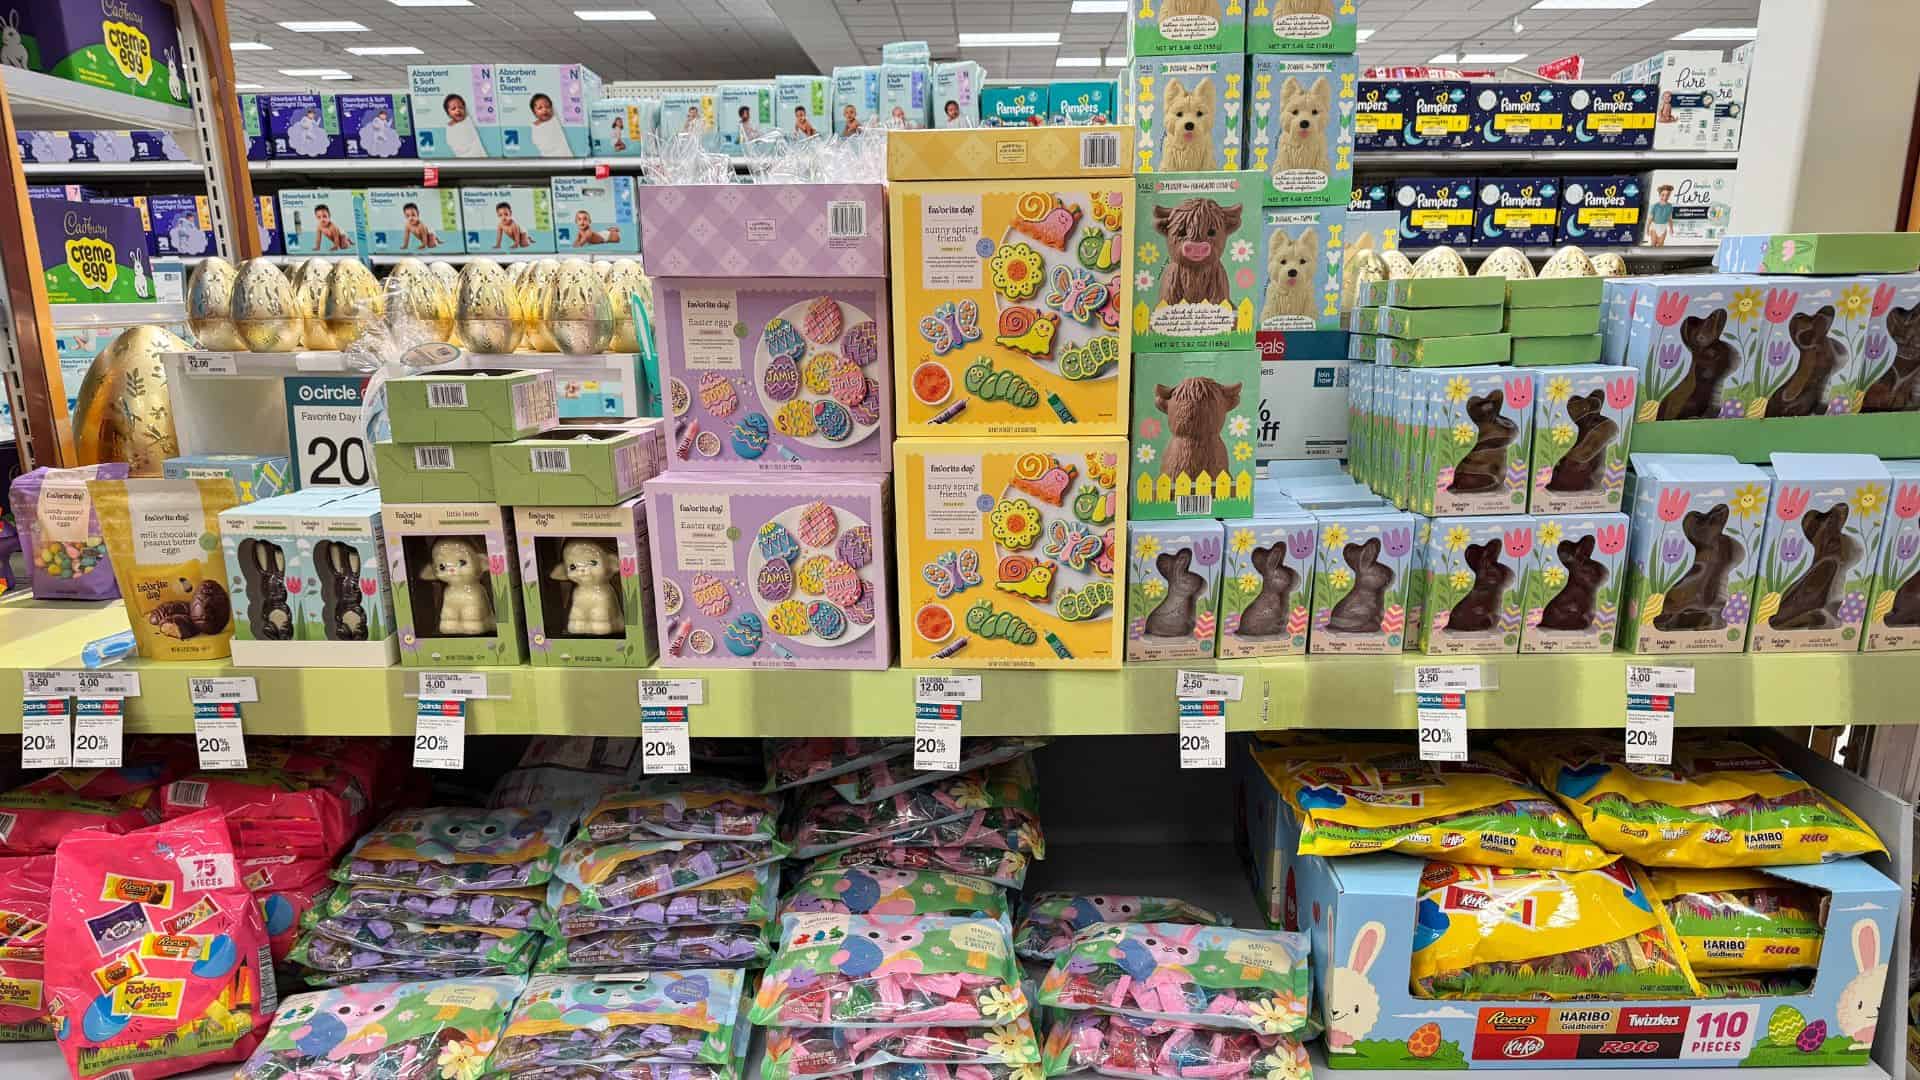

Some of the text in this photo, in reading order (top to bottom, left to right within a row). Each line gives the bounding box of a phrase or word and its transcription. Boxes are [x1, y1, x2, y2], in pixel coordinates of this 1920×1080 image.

[109, 27, 148, 58] creme
[119, 47, 144, 75] egg
[482, 69, 490, 80] N
[499, 69, 536, 77] Absorbent
[569, 68, 578, 79] N
[1675, 67, 1706, 89] Pure
[420, 77, 434, 85] Soft
[507, 76, 521, 84] Soft
[499, 84, 527, 93] Diapers
[996, 103, 1034, 116] Pampers
[1061, 102, 1099, 116] Pampers
[1357, 101, 1387, 112] mpers
[1416, 99, 1457, 114] Pampers
[1501, 98, 1541, 112] Pampers
[1593, 97, 1633, 113] Pampers
[1351, 200, 1371, 211] pers
[1417, 193, 1458, 209] Pampers
[1501, 192, 1542, 207] Pampers
[1584, 191, 1625, 207] Pampers
[63, 210, 108, 238] Cadbury
[925, 224, 979, 237] sunny spring
[937, 233, 967, 243] friends
[70, 244, 113, 263] creme
[82, 261, 108, 283] egg
[688, 317, 733, 329] Easter eggs
[1256, 337, 1285, 354] eals
[767, 370, 797, 383] JAMIE
[301, 411, 356, 425] Favorite Day
[1257, 421, 1280, 441] ff
[307, 436, 371, 487] 20
[928, 482, 979, 493] sunny spring
[939, 490, 967, 499] friends
[446, 510, 479, 519] little lamb
[681, 521, 705, 530] Easter
[140, 530, 198, 539] milk chocolate
[143, 538, 197, 548] peanut butter
[161, 547, 182, 556] eggs
[760, 571, 791, 584] JAMIE
[30, 677, 49, 688] 3.50
[79, 678, 99, 687] 4.00
[1418, 673, 1439, 683] 2.50
[1630, 673, 1650, 682] 4.00
[194, 684, 213, 693] 4.00
[425, 680, 446, 689] 4.00
[643, 686, 668, 696] 12.00
[920, 683, 944, 692] 12.00
[1183, 680, 1202, 689] 2.50
[1421, 727, 1441, 743] 20
[1627, 730, 1648, 745] 20
[24, 735, 45, 750] 20
[77, 735, 98, 750] 20
[199, 738, 220, 752] 20
[416, 735, 438, 750] 20
[645, 742, 666, 756] 20
[916, 738, 936, 753] 20
[1181, 736, 1200, 751] 20
[1480, 833, 1517, 847] HARIBO
[1744, 831, 1783, 843] HARIBO
[193, 858, 217, 878] 75
[1703, 939, 1745, 950] HARIBO
[1763, 944, 1800, 955] Rolo
[124, 982, 161, 996] Robin
[144, 990, 173, 1002] eggs
[148, 1001, 169, 1009] minis
[1487, 1011, 1536, 1025] Reese's
[1559, 1011, 1610, 1022] HARIBO
[1628, 1013, 1680, 1027] Twizzlers
[1696, 1012, 1748, 1038] 110
[1600, 1040, 1659, 1054] Rolo
[1692, 1040, 1741, 1053] PIECES
